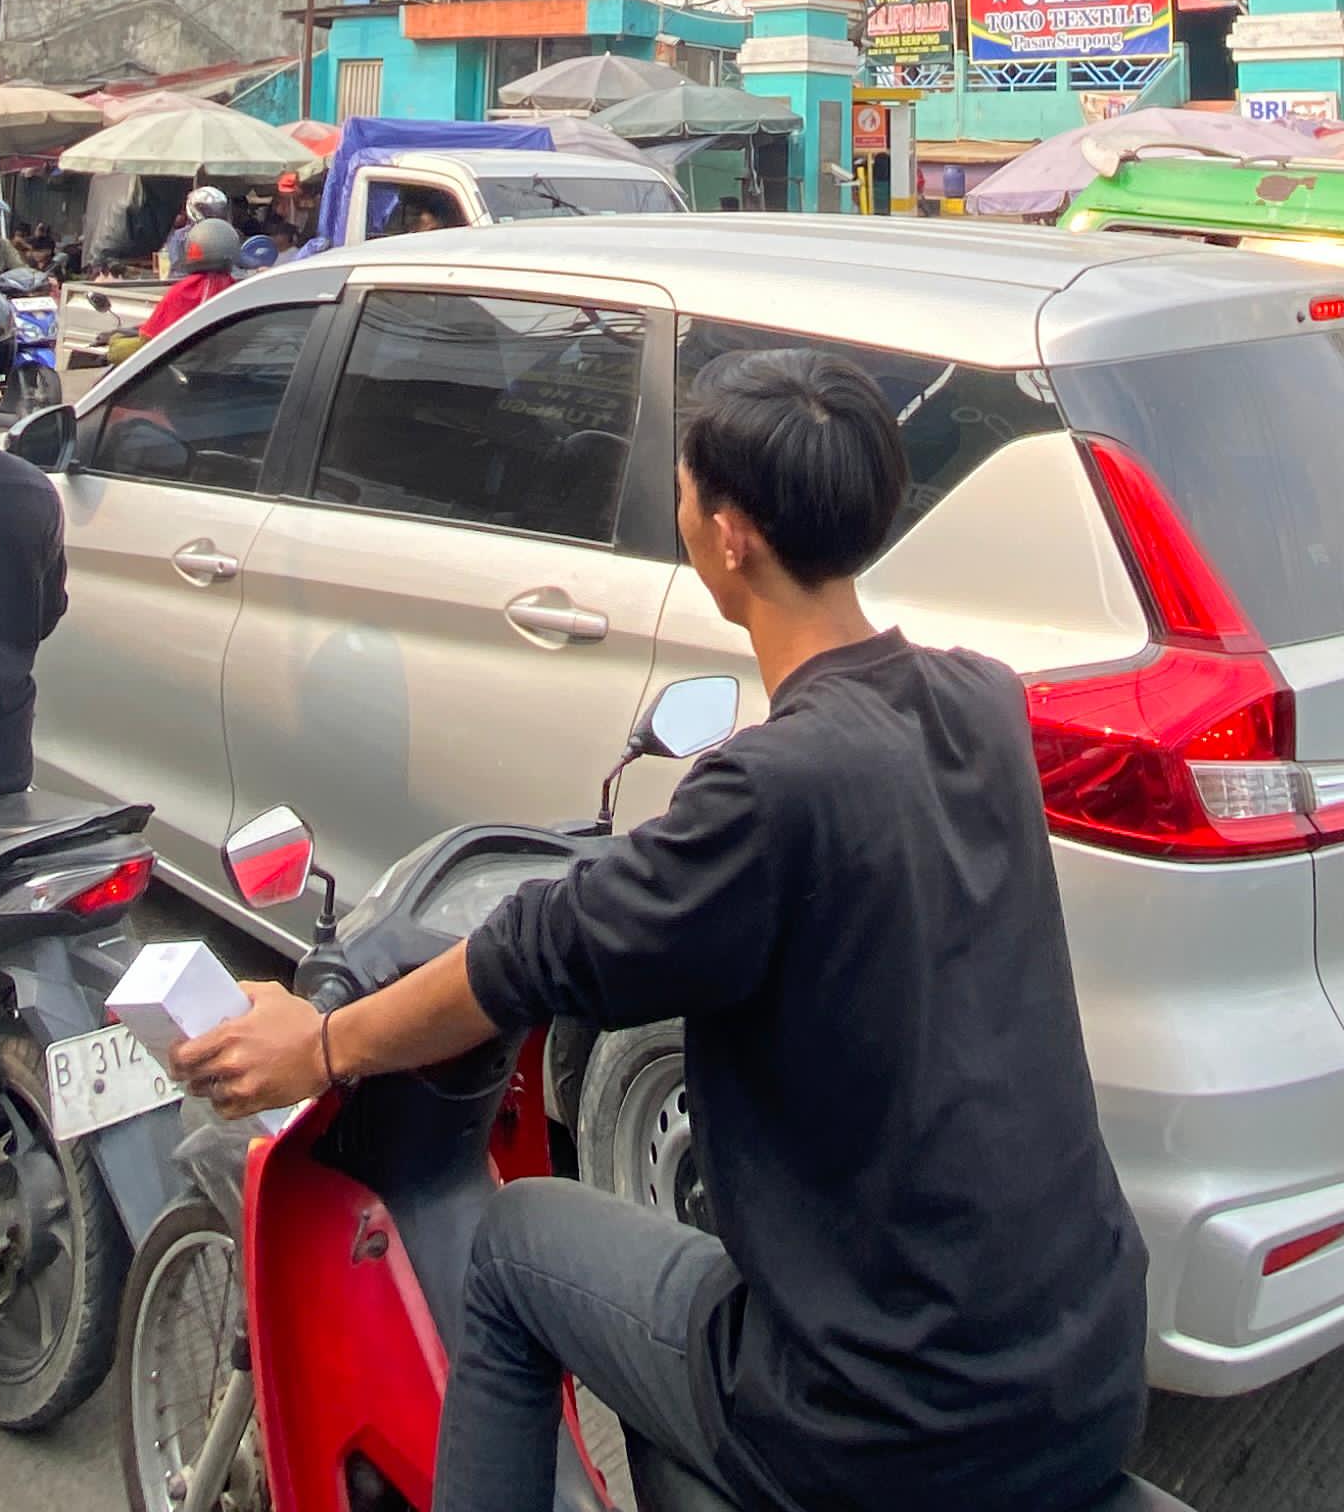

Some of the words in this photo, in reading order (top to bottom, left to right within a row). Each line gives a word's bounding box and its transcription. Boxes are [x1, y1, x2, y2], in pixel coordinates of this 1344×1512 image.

[985, 11, 1045, 33] TOKO
[1048, 4, 1154, 30] TEXTILE
[875, 36, 900, 48] PASAR
[901, 33, 940, 47] SERPONG
[1011, 34, 1056, 52] Pasar
[1056, 30, 1124, 53] Serpong
[1250, 100, 1287, 120] BRI
[55, 1053, 72, 1088] B
[90, 1032, 142, 1075] 312
